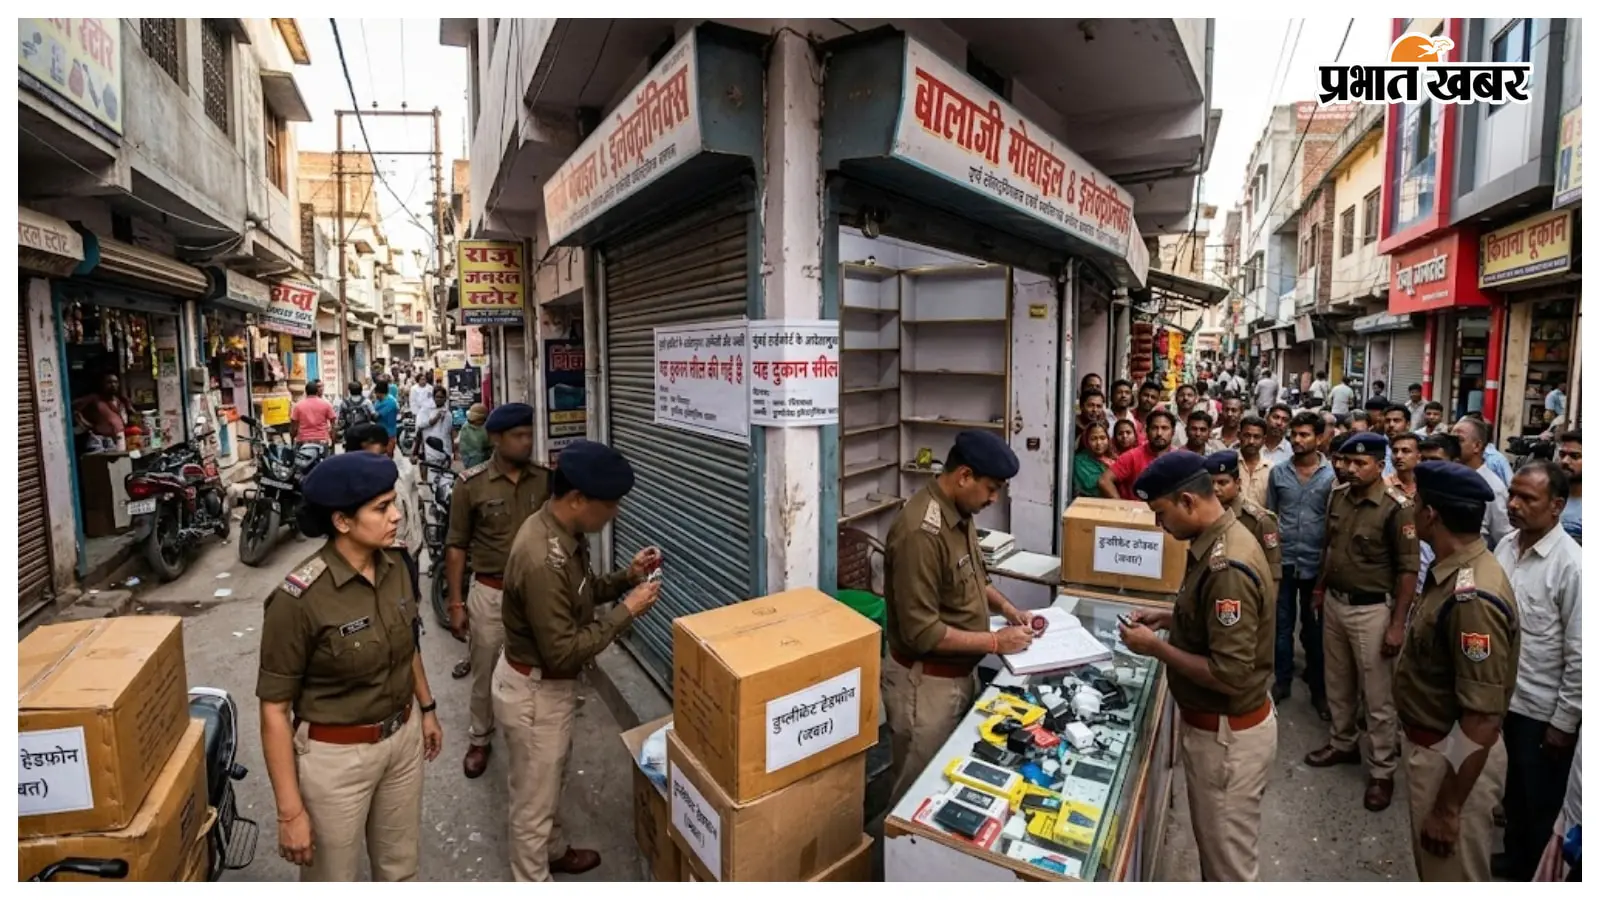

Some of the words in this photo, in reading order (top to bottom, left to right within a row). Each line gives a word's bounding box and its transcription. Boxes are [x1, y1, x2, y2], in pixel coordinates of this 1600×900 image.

[915, 67, 1004, 165] बालाजी
[464, 247, 520, 268] राजू
[464, 270, 520, 284] जनरल
[466, 286, 519, 304] स्टोर
[772, 361, 808, 385] दुकान
[812, 355, 838, 378] सील
